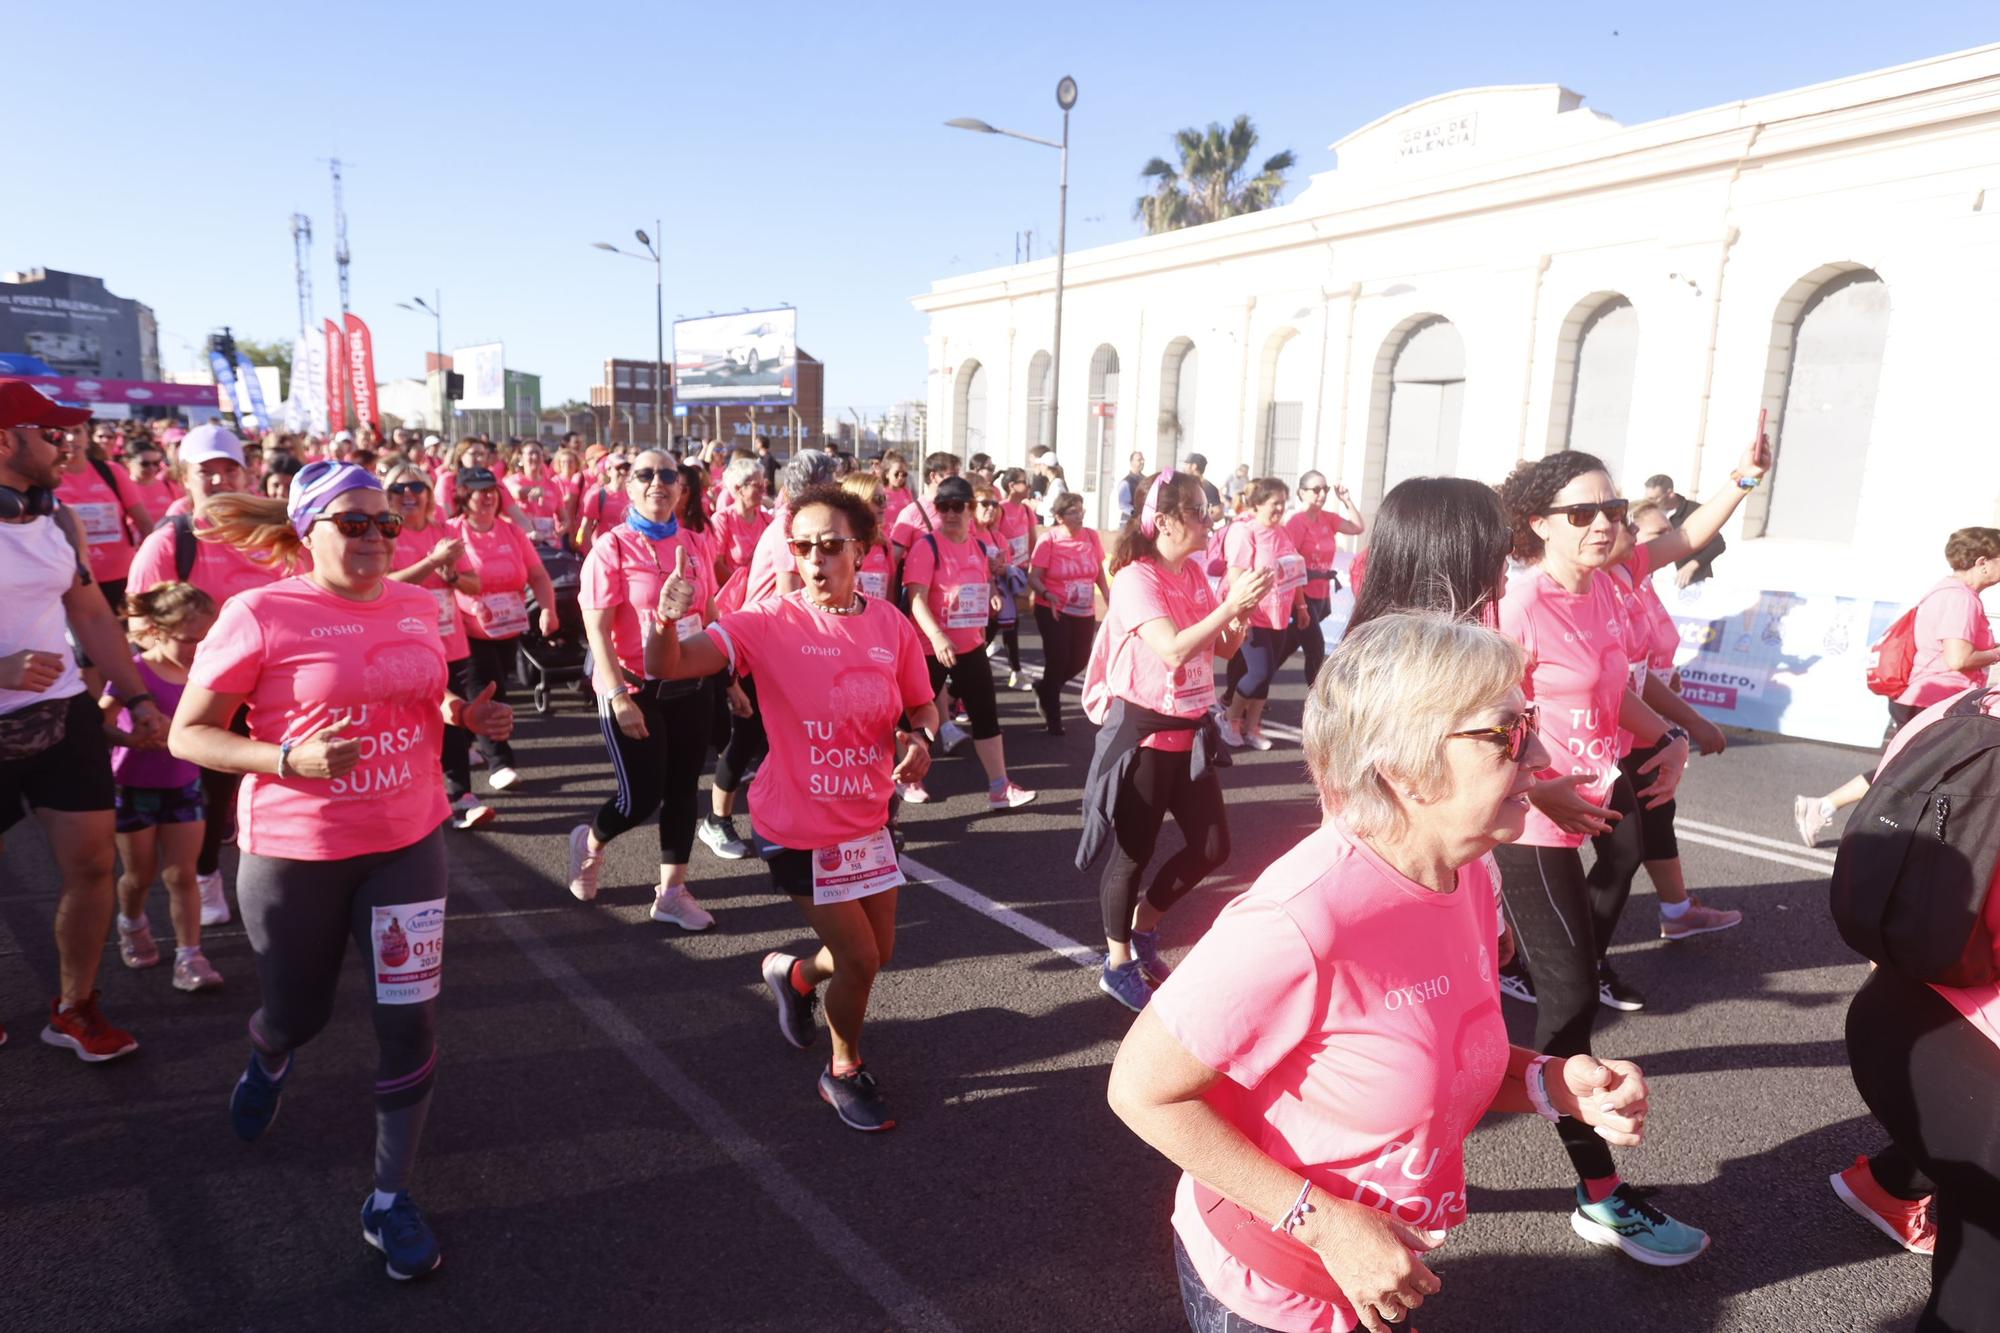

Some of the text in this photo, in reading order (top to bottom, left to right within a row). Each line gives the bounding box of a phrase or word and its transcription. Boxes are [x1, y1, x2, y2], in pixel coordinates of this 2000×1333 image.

[310, 624, 364, 639] OYSHO
[801, 645, 841, 657] OYSHO
[1187, 667, 1202, 678] 016
[1569, 708, 1600, 730] TU
[803, 720, 833, 740] TU
[809, 773, 874, 796] SUMA
[844, 848, 866, 861] 016
[413, 938, 441, 956] 016
[1385, 975, 1450, 1011] OYSHO
